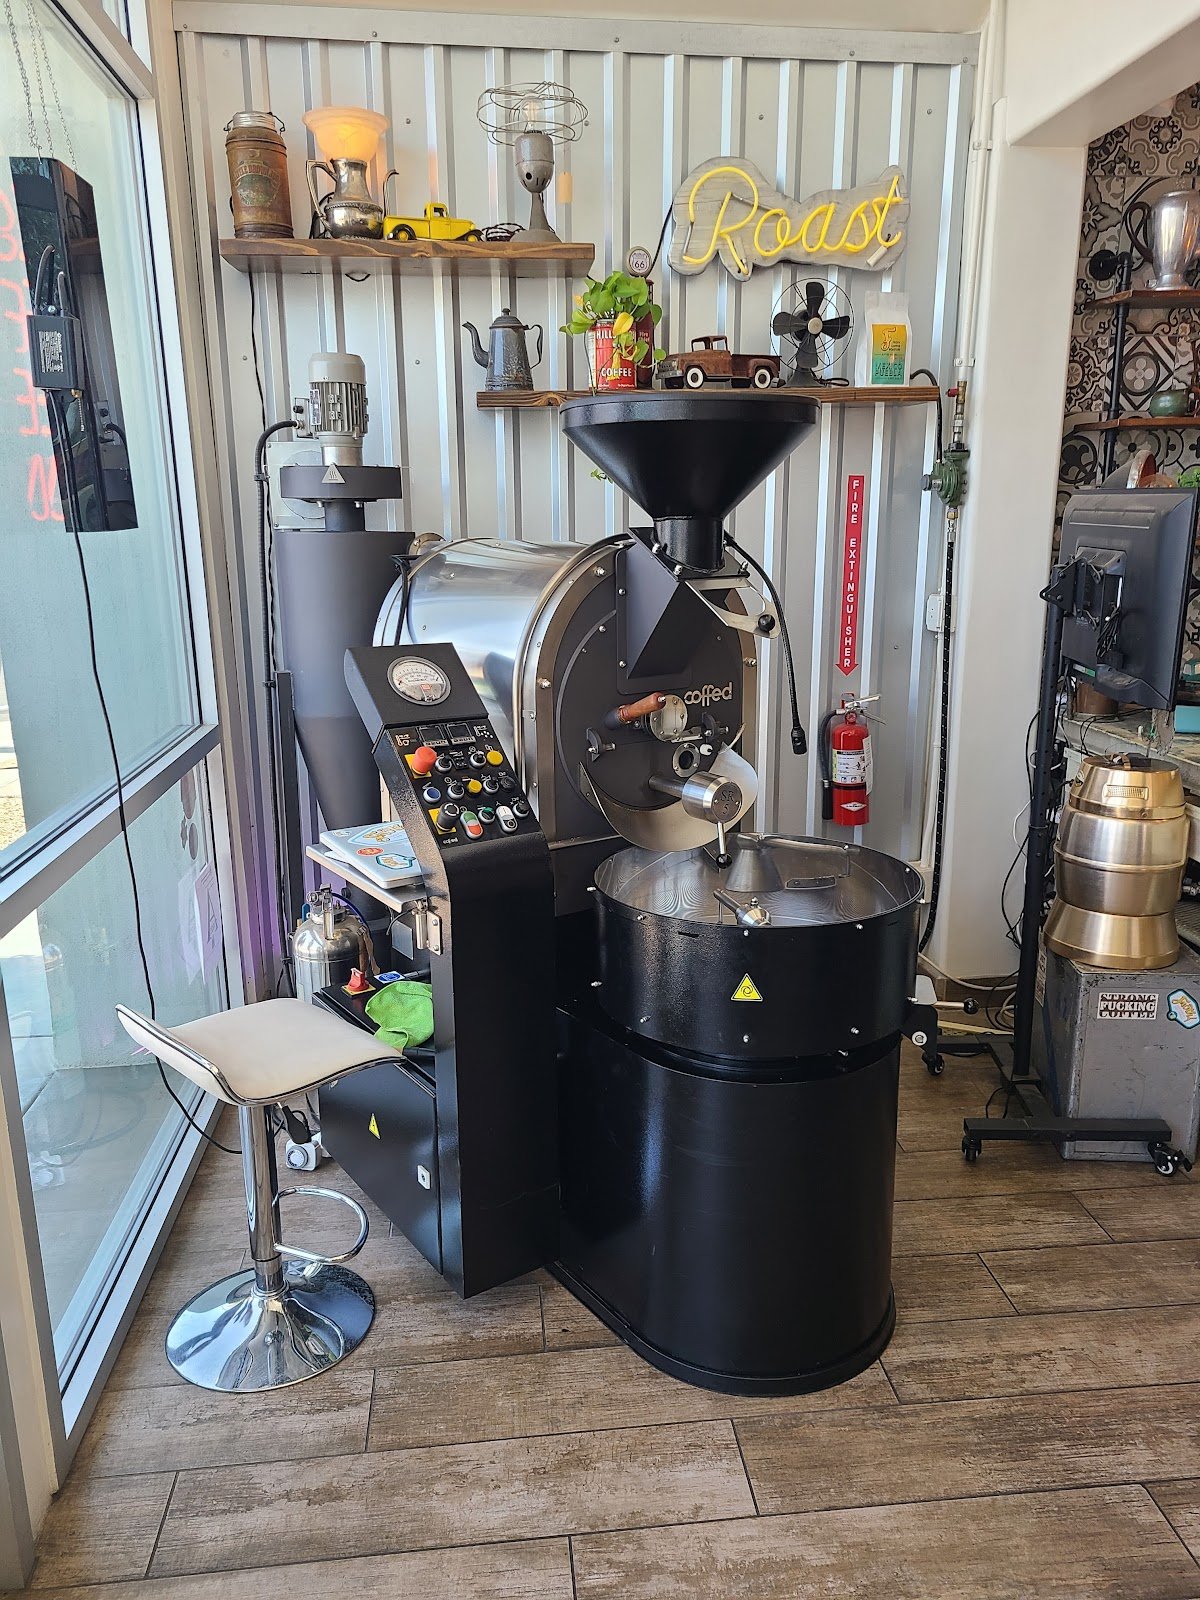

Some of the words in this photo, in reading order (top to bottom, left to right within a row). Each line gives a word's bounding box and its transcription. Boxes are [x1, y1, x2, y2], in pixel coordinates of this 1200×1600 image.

[682, 166, 903, 275] Roast
[634, 260, 646, 269] 66
[601, 368, 632, 377] COFFEE
[851, 479, 860, 524] FIRE
[843, 538, 857, 668] EXTINGUISHER
[684, 681, 733, 707] coffed
[720, 790, 734, 802] SR
[722, 803, 729, 815] 5
[1100, 993, 1157, 1001] STRONG
[1099, 1001, 1156, 1011] FUCKING
